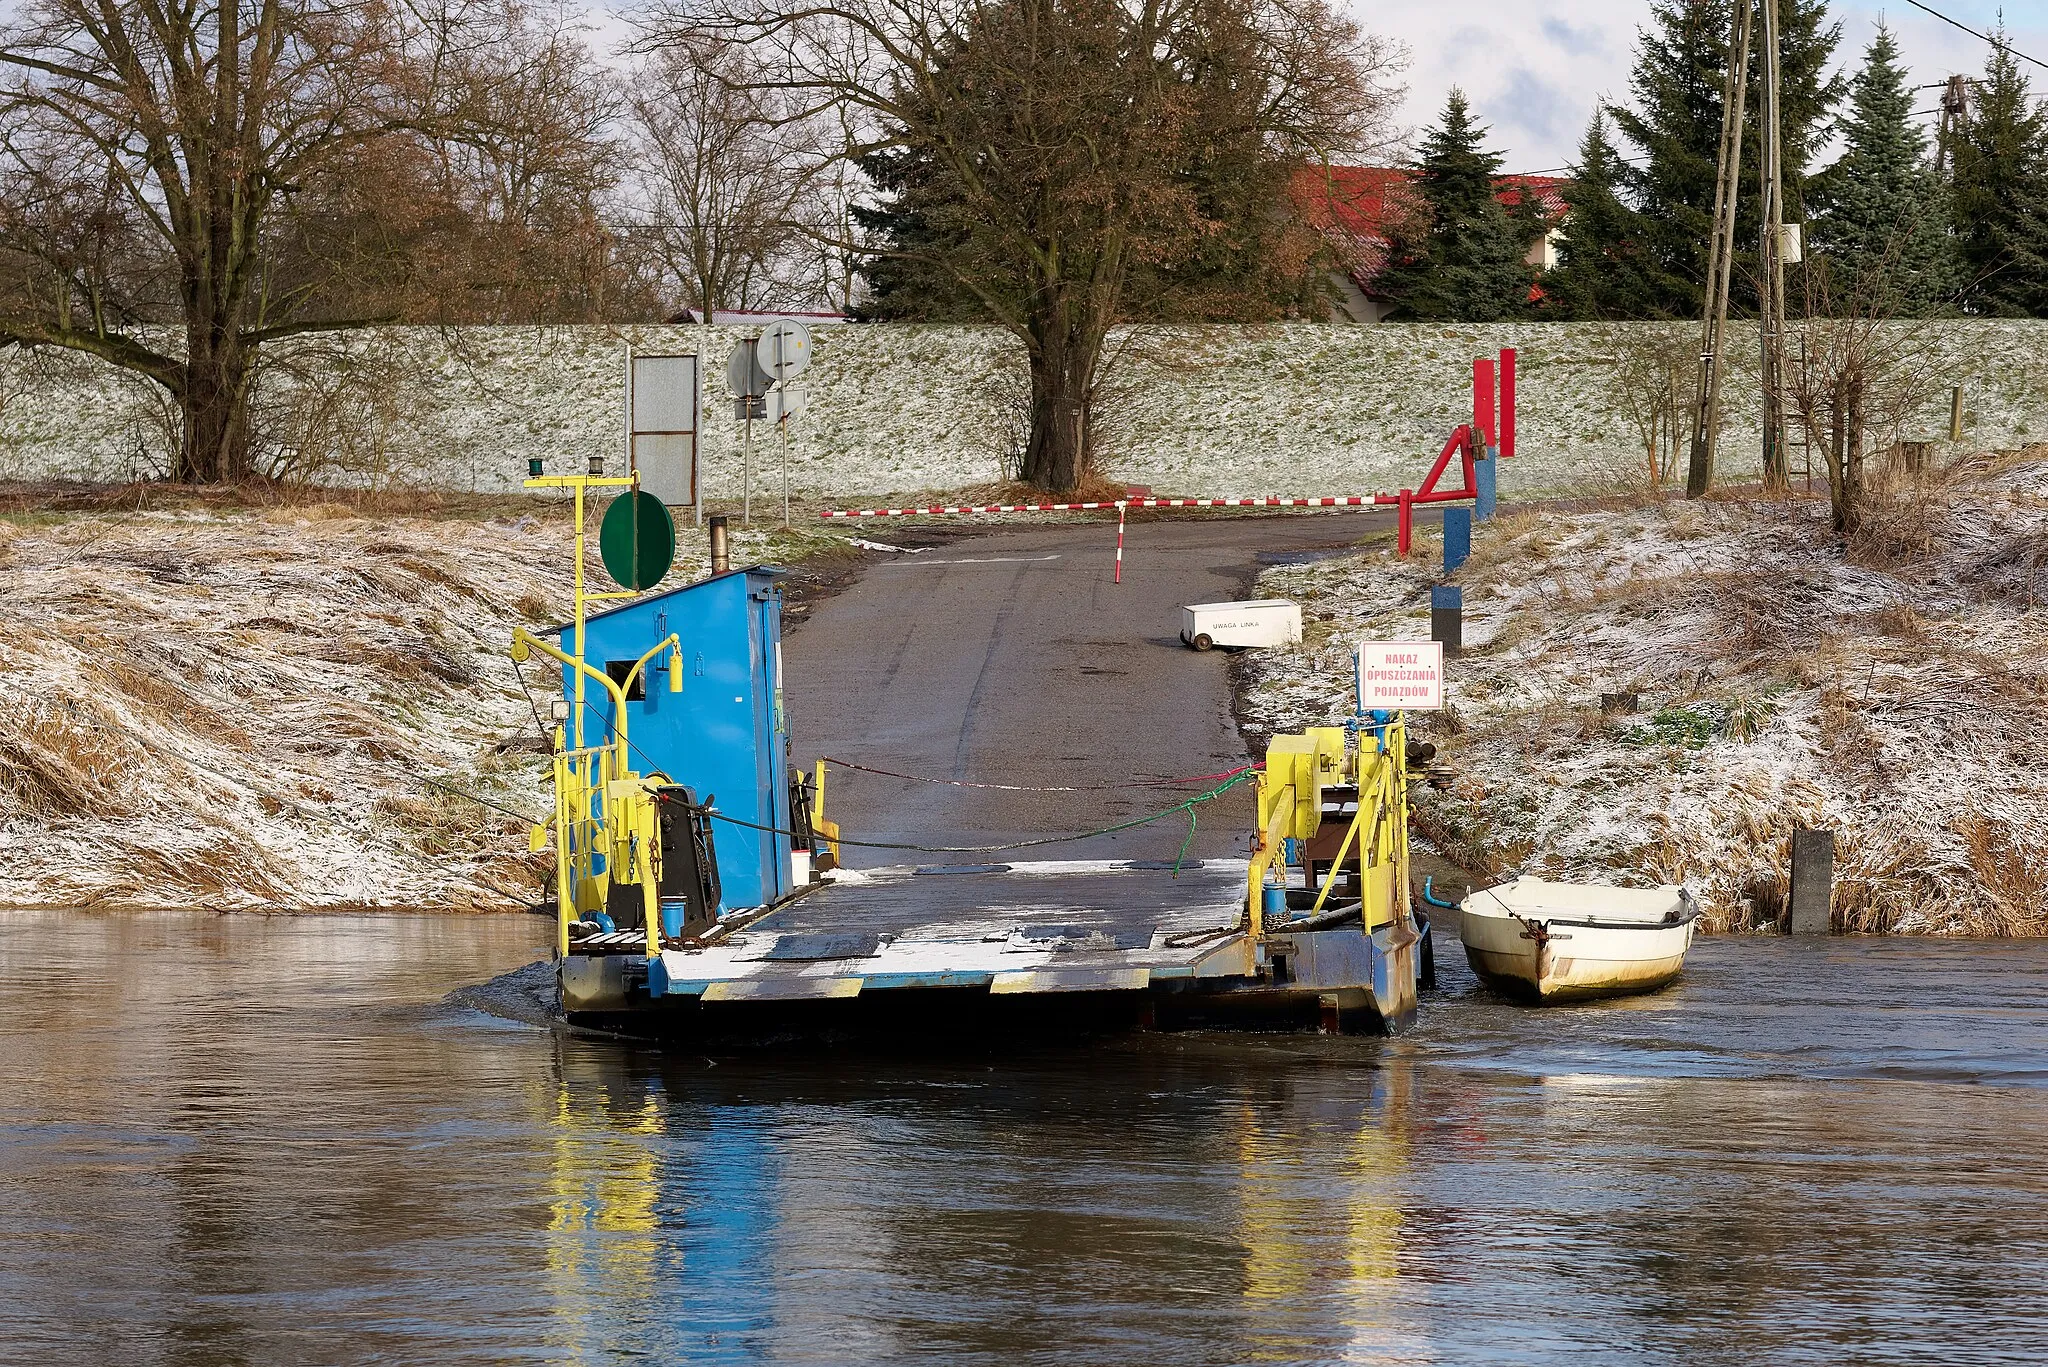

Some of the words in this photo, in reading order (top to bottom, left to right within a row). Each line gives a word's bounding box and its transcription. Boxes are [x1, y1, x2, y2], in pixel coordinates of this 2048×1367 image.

[1212, 622, 1237, 630] UWAGA
[1385, 654, 1418, 664] NAKAZ
[1367, 670, 1436, 681] OPUSZCZANIA
[1374, 685, 1429, 697] POJAZDÓW
